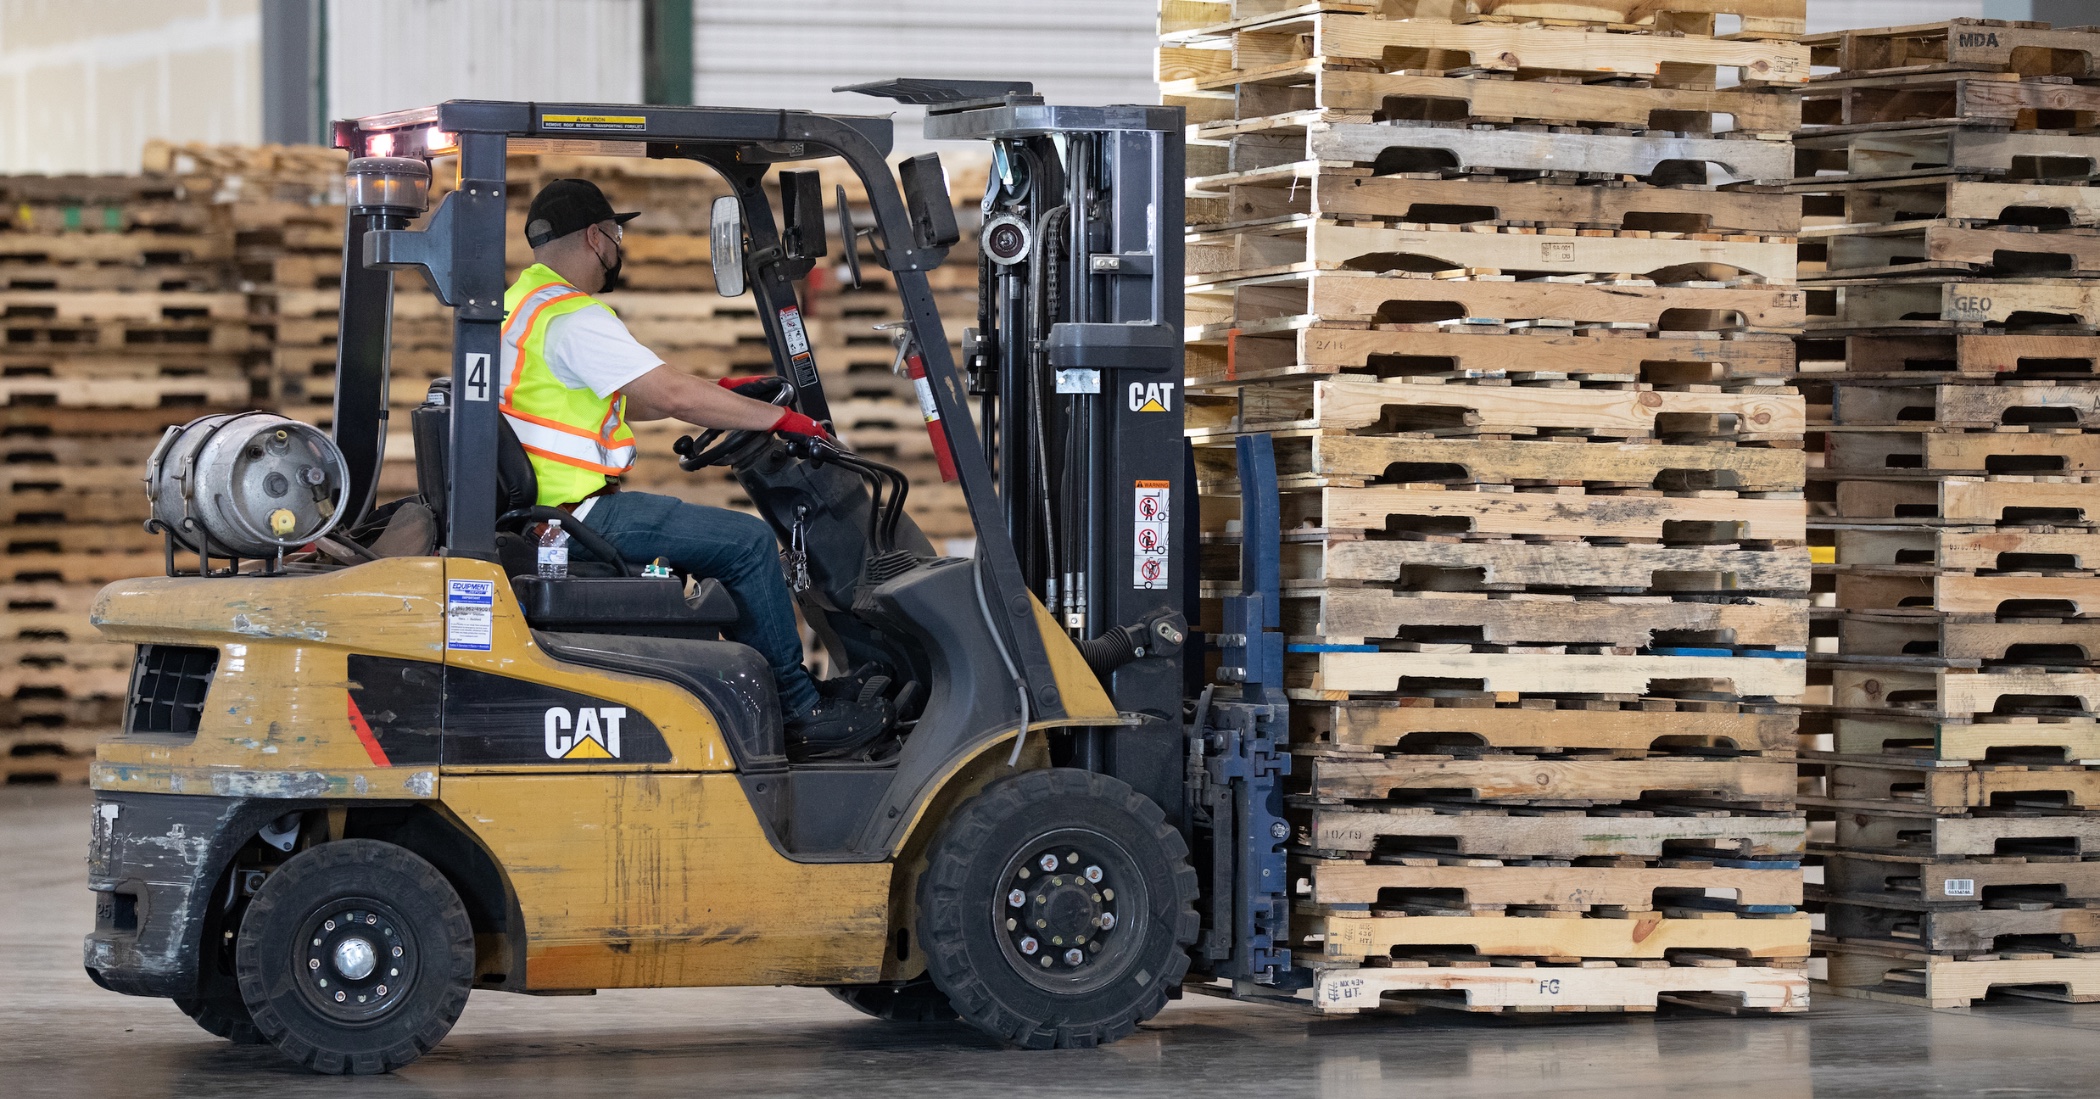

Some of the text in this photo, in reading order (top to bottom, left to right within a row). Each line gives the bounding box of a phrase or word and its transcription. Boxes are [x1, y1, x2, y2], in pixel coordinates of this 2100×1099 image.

[1959, 32, 1999, 47] MDA
[1955, 296, 1992, 312] GEO
[468, 356, 487, 398] 4
[1128, 382, 1175, 412] CAT
[452, 583, 489, 591] EQUIPMENT
[544, 706, 627, 759] CAT
[97, 903, 112, 918] 25
[1540, 979, 1560, 994] FG
